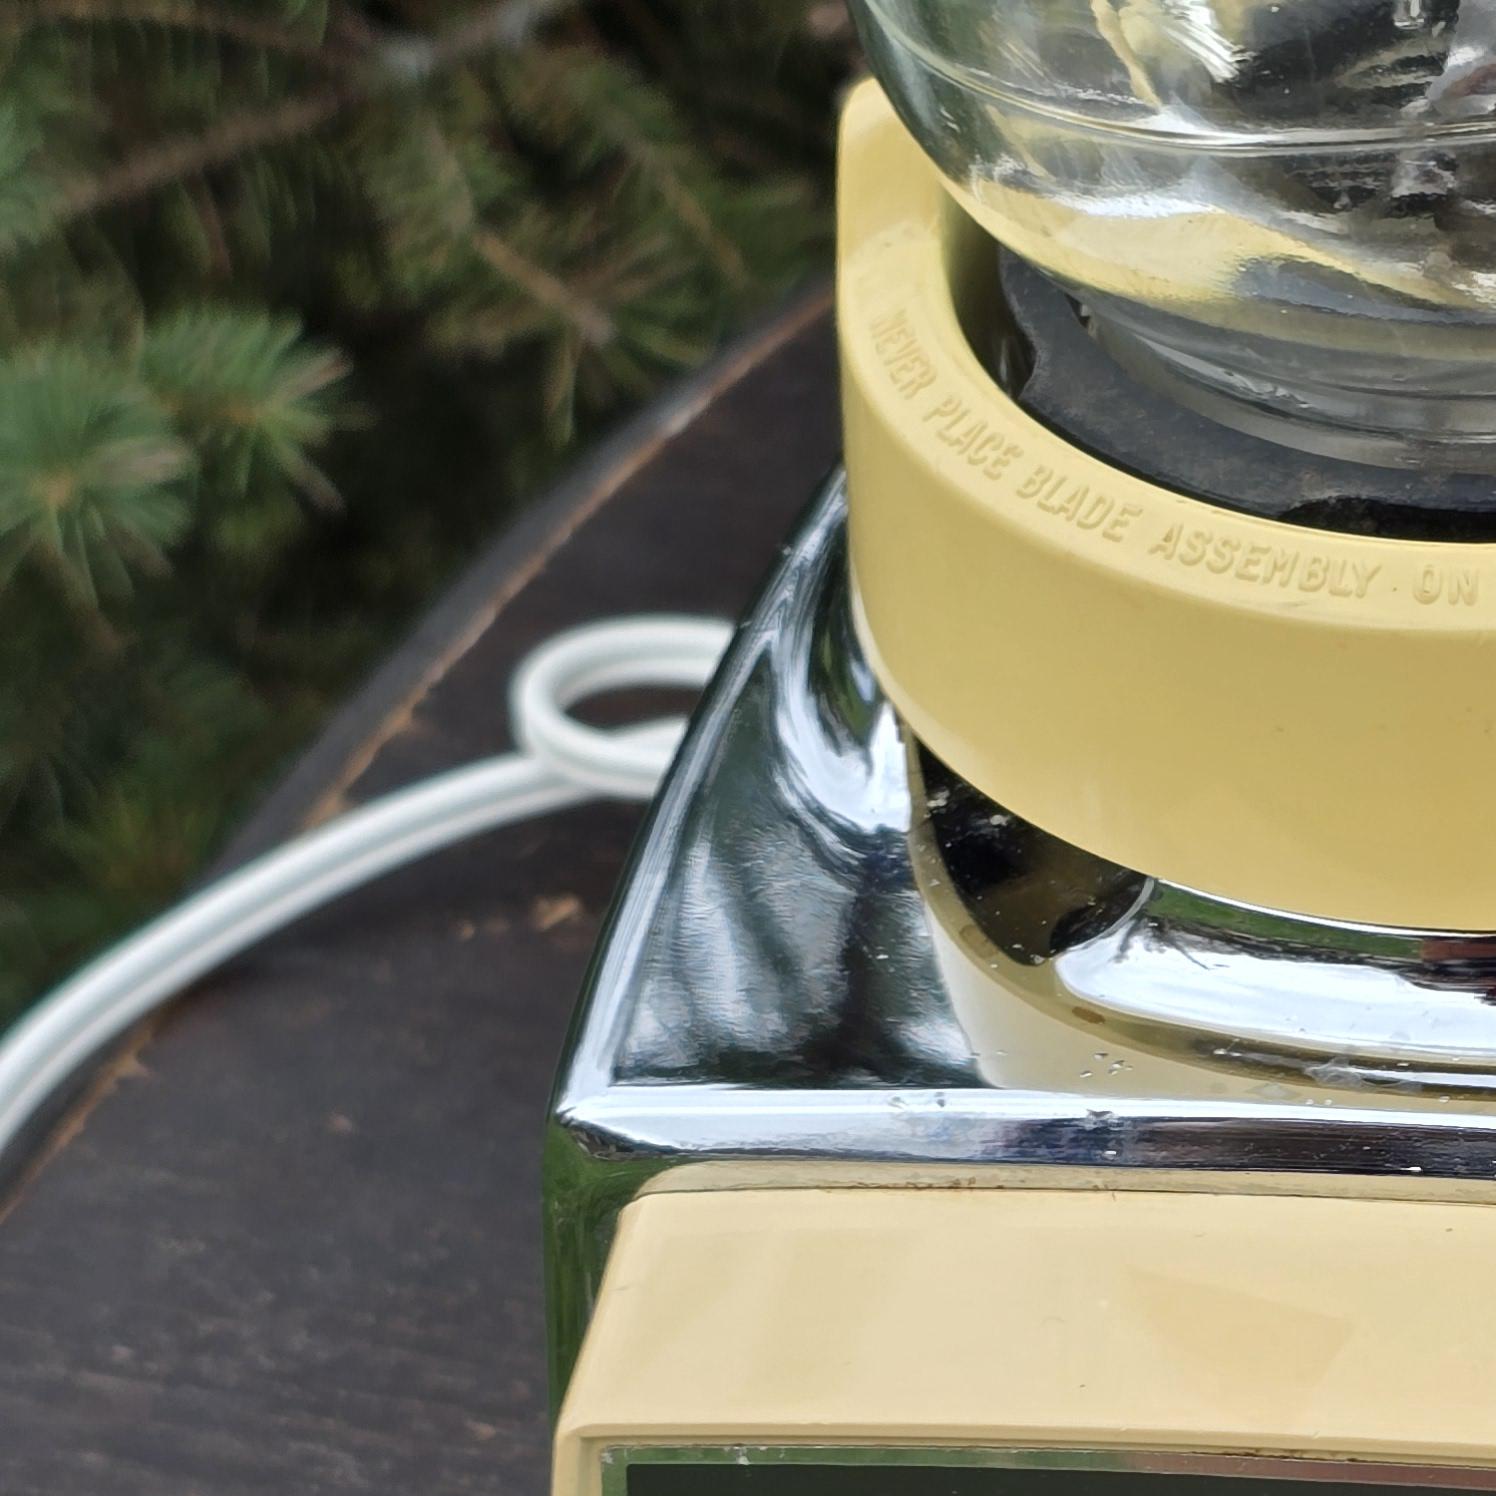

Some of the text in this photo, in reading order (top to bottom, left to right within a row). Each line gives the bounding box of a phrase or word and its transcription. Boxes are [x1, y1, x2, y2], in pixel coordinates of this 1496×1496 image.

[868, 306, 938, 401] NEVER
[922, 394, 1024, 482] PLACE
[1014, 463, 1142, 543] BLADE
[1147, 521, 1380, 600] ASSEMBLY
[1411, 563, 1479, 606] ON
